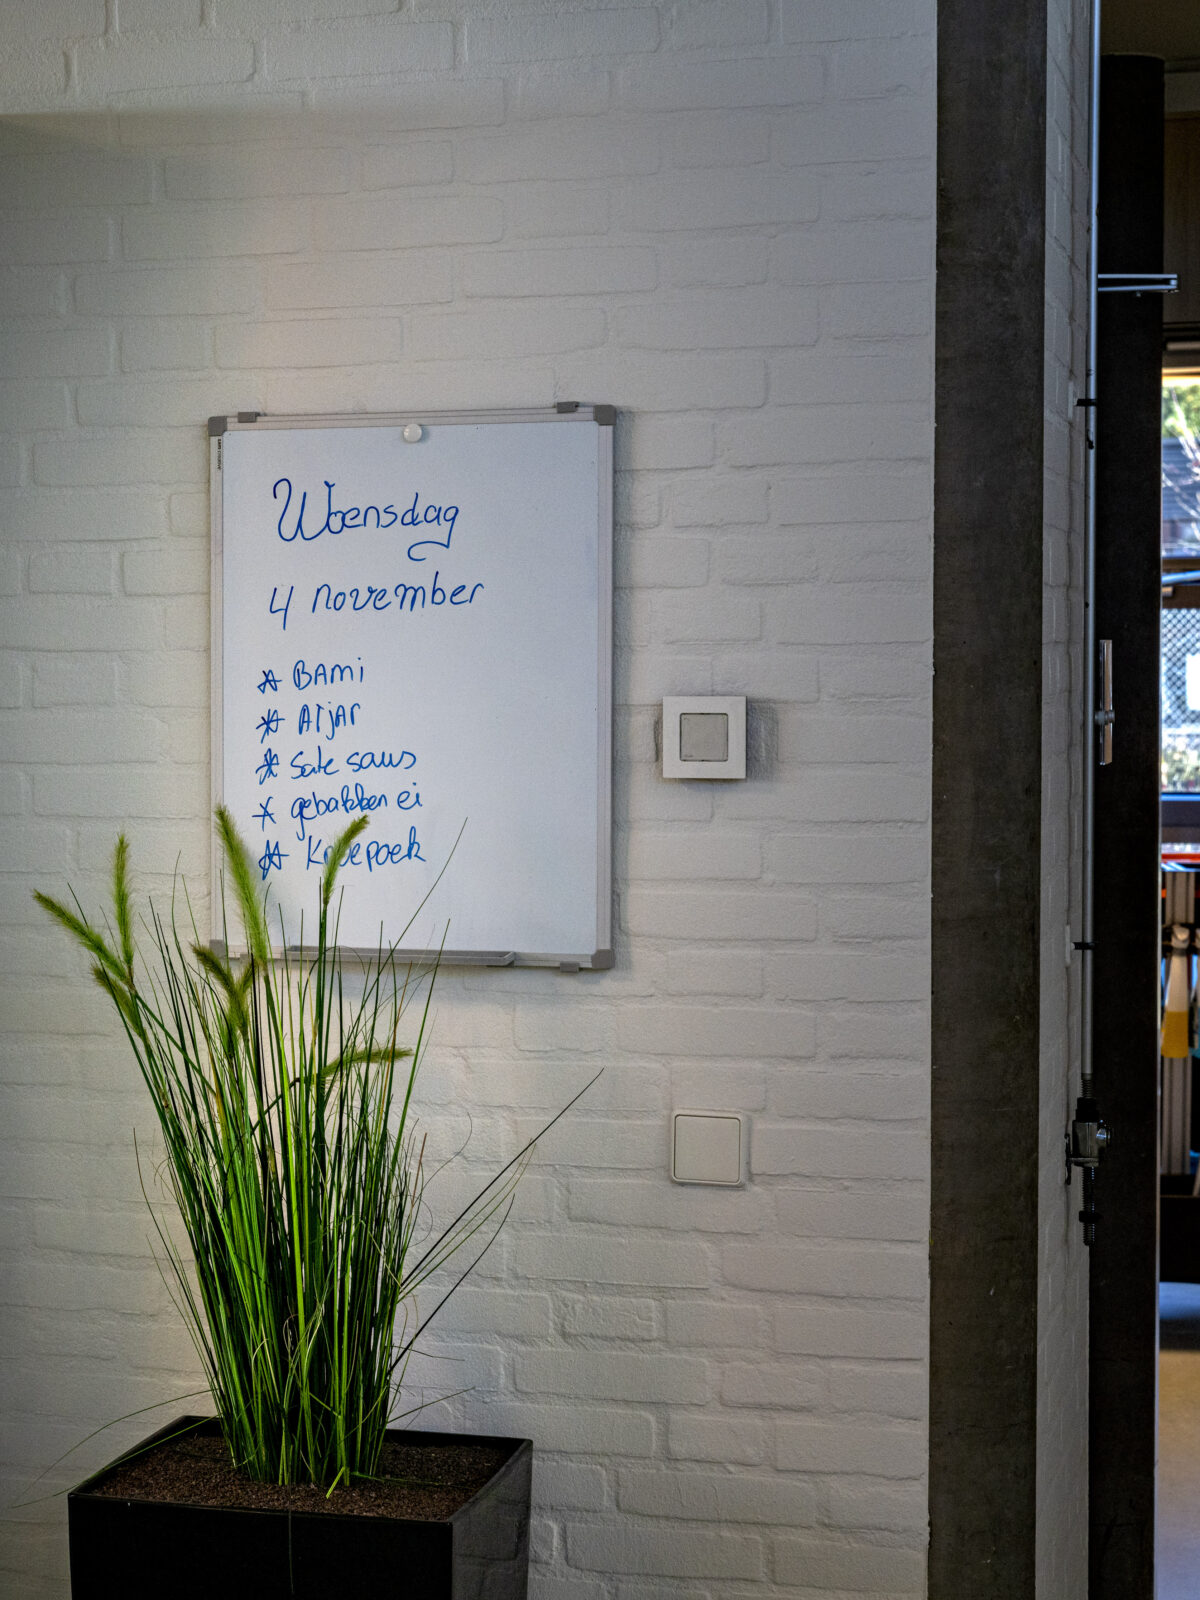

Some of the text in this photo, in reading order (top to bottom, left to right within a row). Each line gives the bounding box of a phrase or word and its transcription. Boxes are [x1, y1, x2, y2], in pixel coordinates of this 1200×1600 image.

[272, 477, 460, 562] Woensdag
[268, 570, 485, 631] 4 november
[290, 782, 423, 841] gebakken ei
